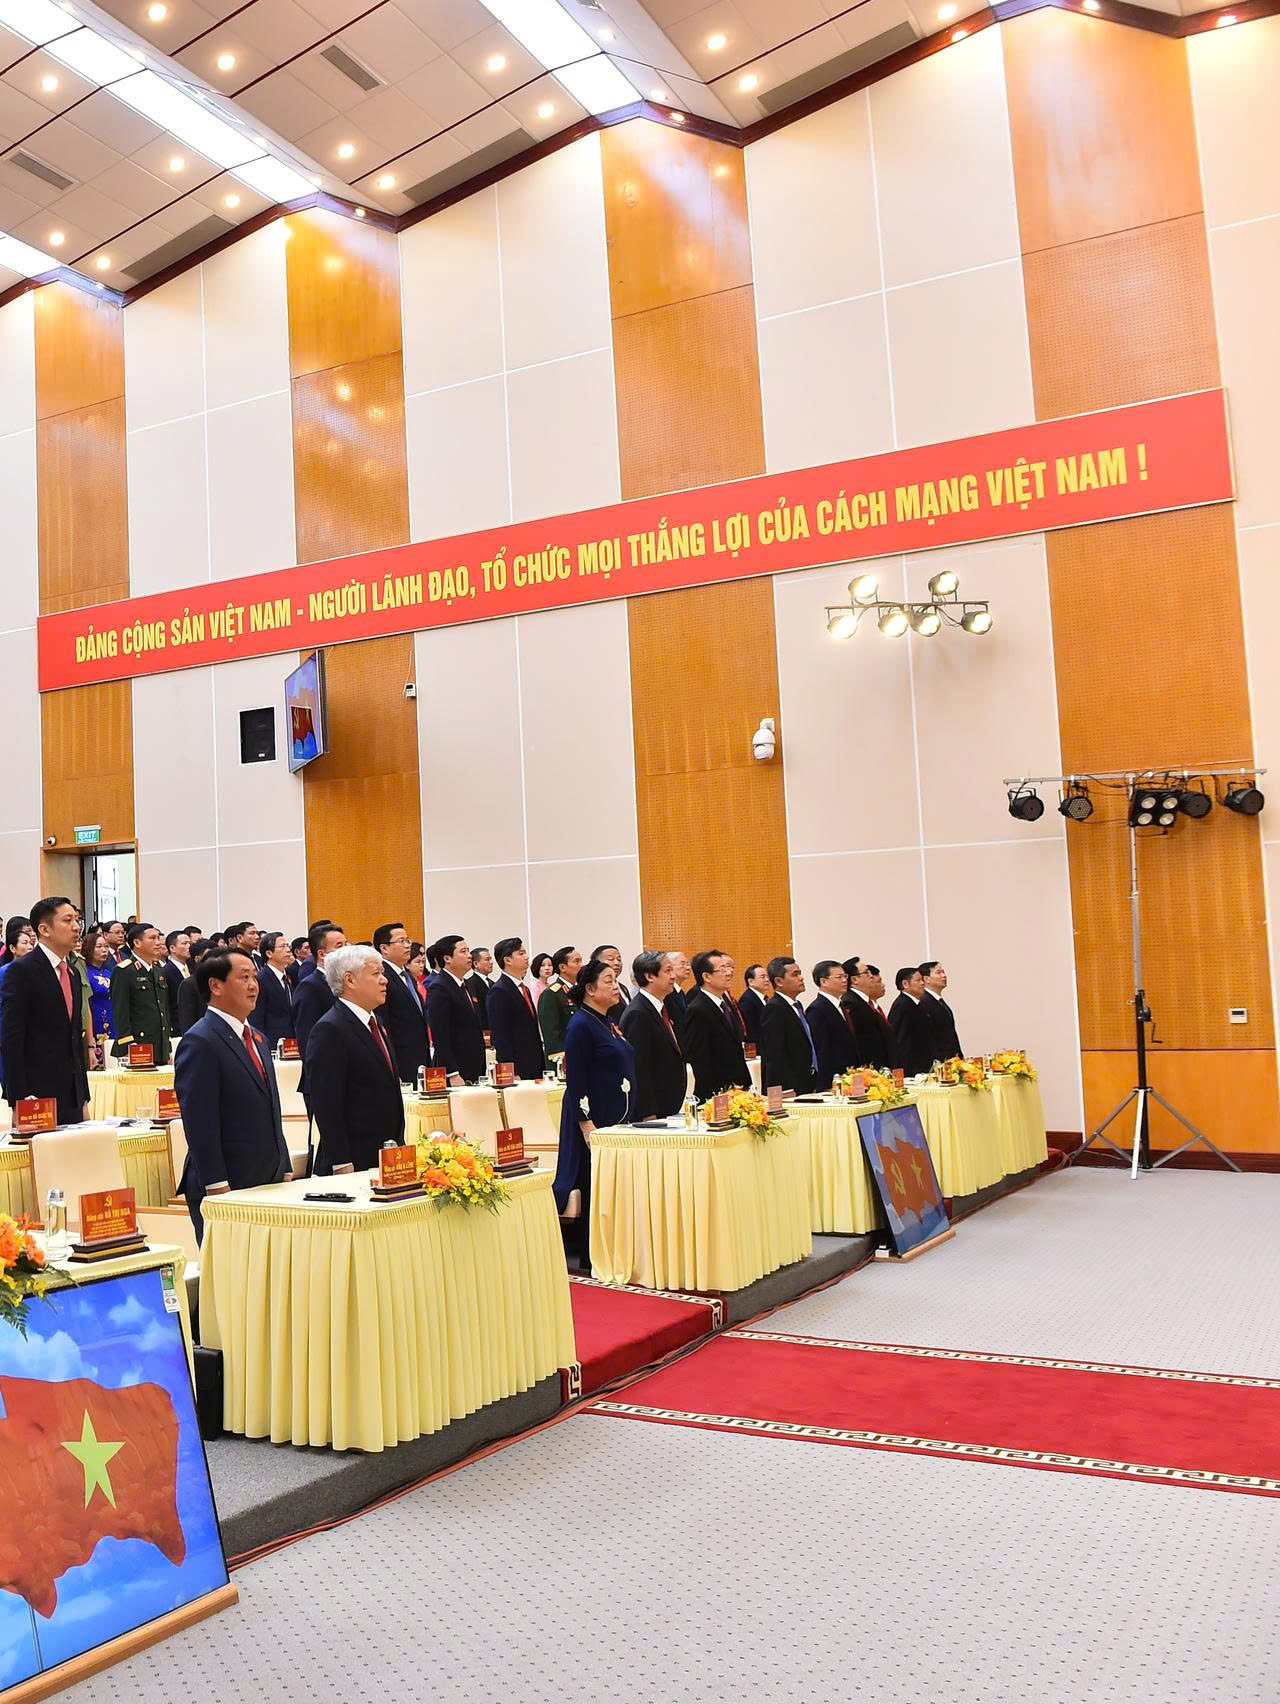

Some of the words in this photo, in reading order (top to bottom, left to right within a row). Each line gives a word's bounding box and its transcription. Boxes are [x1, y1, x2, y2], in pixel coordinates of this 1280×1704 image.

[75, 626, 118, 663] ĐẢNG
[122, 620, 166, 660] CỘNG
[170, 607, 205, 647] SẢN
[209, 603, 245, 643] VIỆT
[250, 598, 292, 633] NAM
[308, 579, 367, 623] NGƯỜI
[371, 573, 423, 612] LÃNH
[427, 565, 476, 606] ĐẠO,
[480, 545, 508, 593] TỔ
[513, 543, 572, 587] CHỨC
[577, 538, 622, 580] MỌI
[626, 516, 706, 567] THẮNG
[711, 511, 751, 559] LỢI
[757, 496, 811, 545] CỦA
[816, 489, 888, 536] CÁCH
[894, 477, 980, 526] MẠNG
[986, 456, 1048, 511] VIỆT
[1056, 447, 1128, 496] NAM
[1136, 443, 1150, 481] !
[78, 831, 96, 840] EXIT
